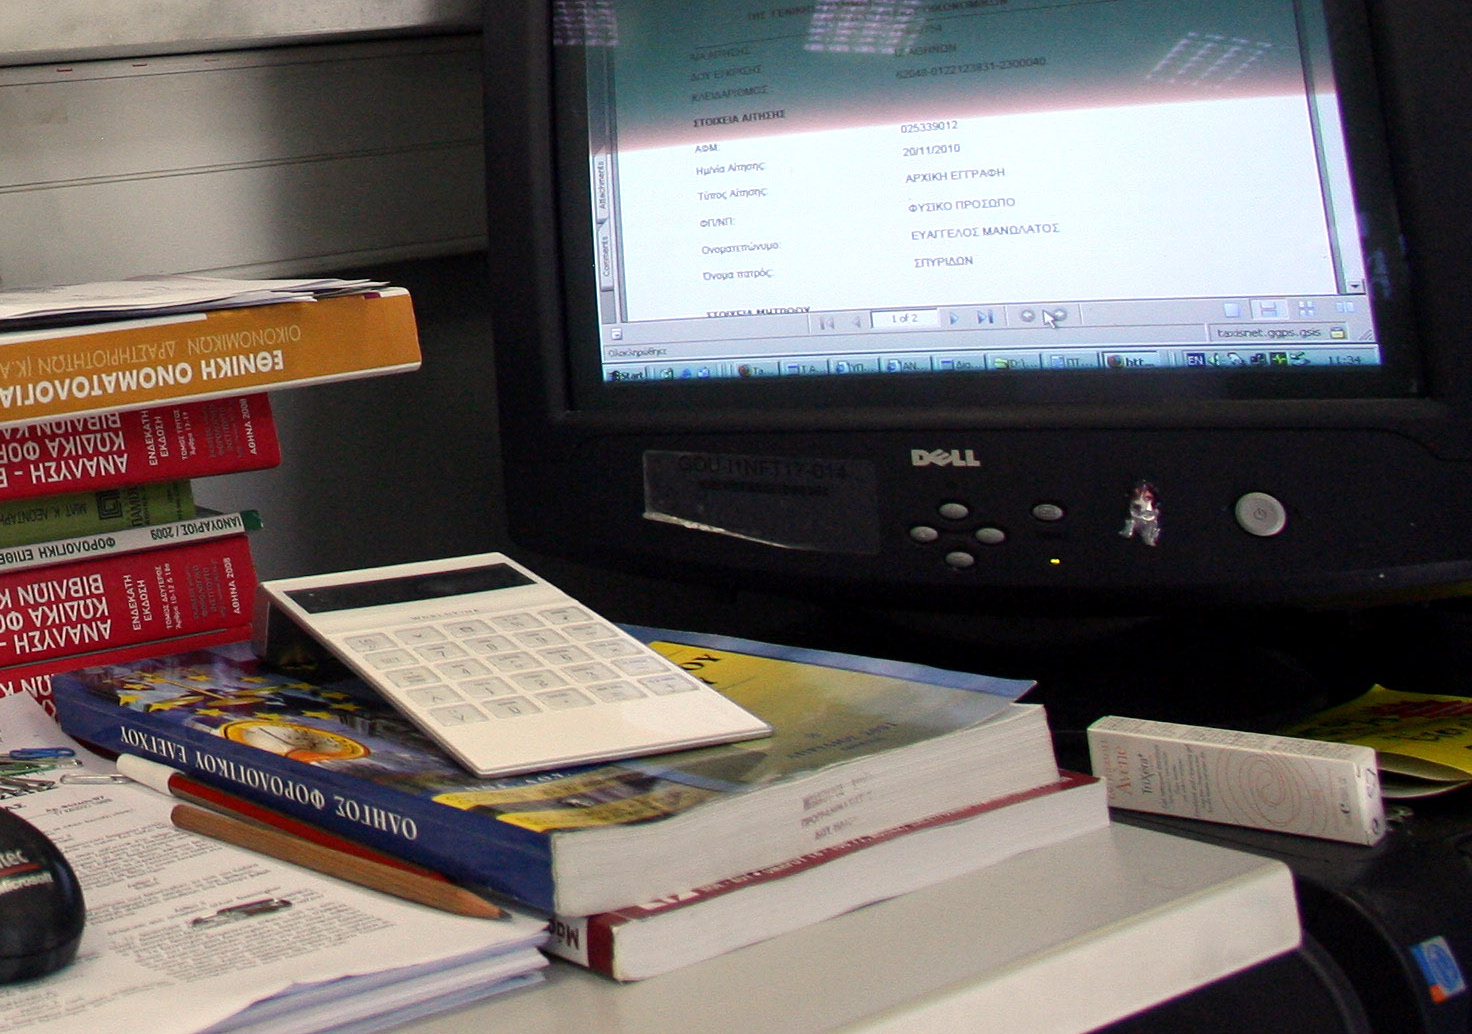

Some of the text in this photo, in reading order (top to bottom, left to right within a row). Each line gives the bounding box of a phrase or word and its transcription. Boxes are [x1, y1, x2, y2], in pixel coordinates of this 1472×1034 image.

[903, 143, 961, 157] 20/11/2010
[905, 168, 1005, 183] ΑΡΧΙΚΗ ΕΓΓΡΑΦΗ
[908, 197, 1016, 213] ΦΥΣΙΚΟ ΠΡΟΣΩΠΟ
[911, 223, 1060, 241] ΕΥΑΓΓΕΛΟΣ ΜΑΝΩΛΑΤΟΣ
[914, 256, 973, 268] ΣΠΥΡΙΔΩΝ
[188, 325, 302, 357] ΟΙΚΟΝΟΜΙΚΩΝ
[38, 340, 176, 376] ΔΡΑΣΤΗΡΙΟΤΗΤΩΝ
[201, 350, 284, 381] ΕΘΝΙΚΗ
[1188, 355, 1204, 366] EN
[45, 431, 125, 458] ΚΩΔΙΚΑ
[141, 410, 158, 466] ΕΝΔΕΚΑΤΗ
[154, 416, 169, 458] ΕΚΔΟΣΗ
[244, 420, 257, 455] ΑΘΗΝΑ
[31, 453, 128, 485] ΑΝΑΛΥΣΗ
[910, 448, 981, 467] DELL
[151, 526, 175, 541] 2009
[183, 516, 241, 537] ΙΑΝΟΥΑΡΙΟΣ
[39, 536, 116, 559] ΦΟΡΟΛΟΓΙΚΗ
[19, 573, 105, 600] ΒΙΒΛΙΩΝ
[137, 579, 153, 621] ΕΚΔΟΣΗ
[229, 580, 241, 614] ΑΘΗΝΑ
[28, 596, 109, 628] ΚΩΔΙΚΑ
[123, 574, 141, 631] ΕΝΔΕΚΑΤΗ
[14, 619, 112, 655] ΑΝΑΛΥΣΗ
[120, 725, 418, 841] ΟΔΗΓΟΣ ΦΟΡΟΛΟΓΙΚΟΥ ΕΛΕΓΧΟΥ
